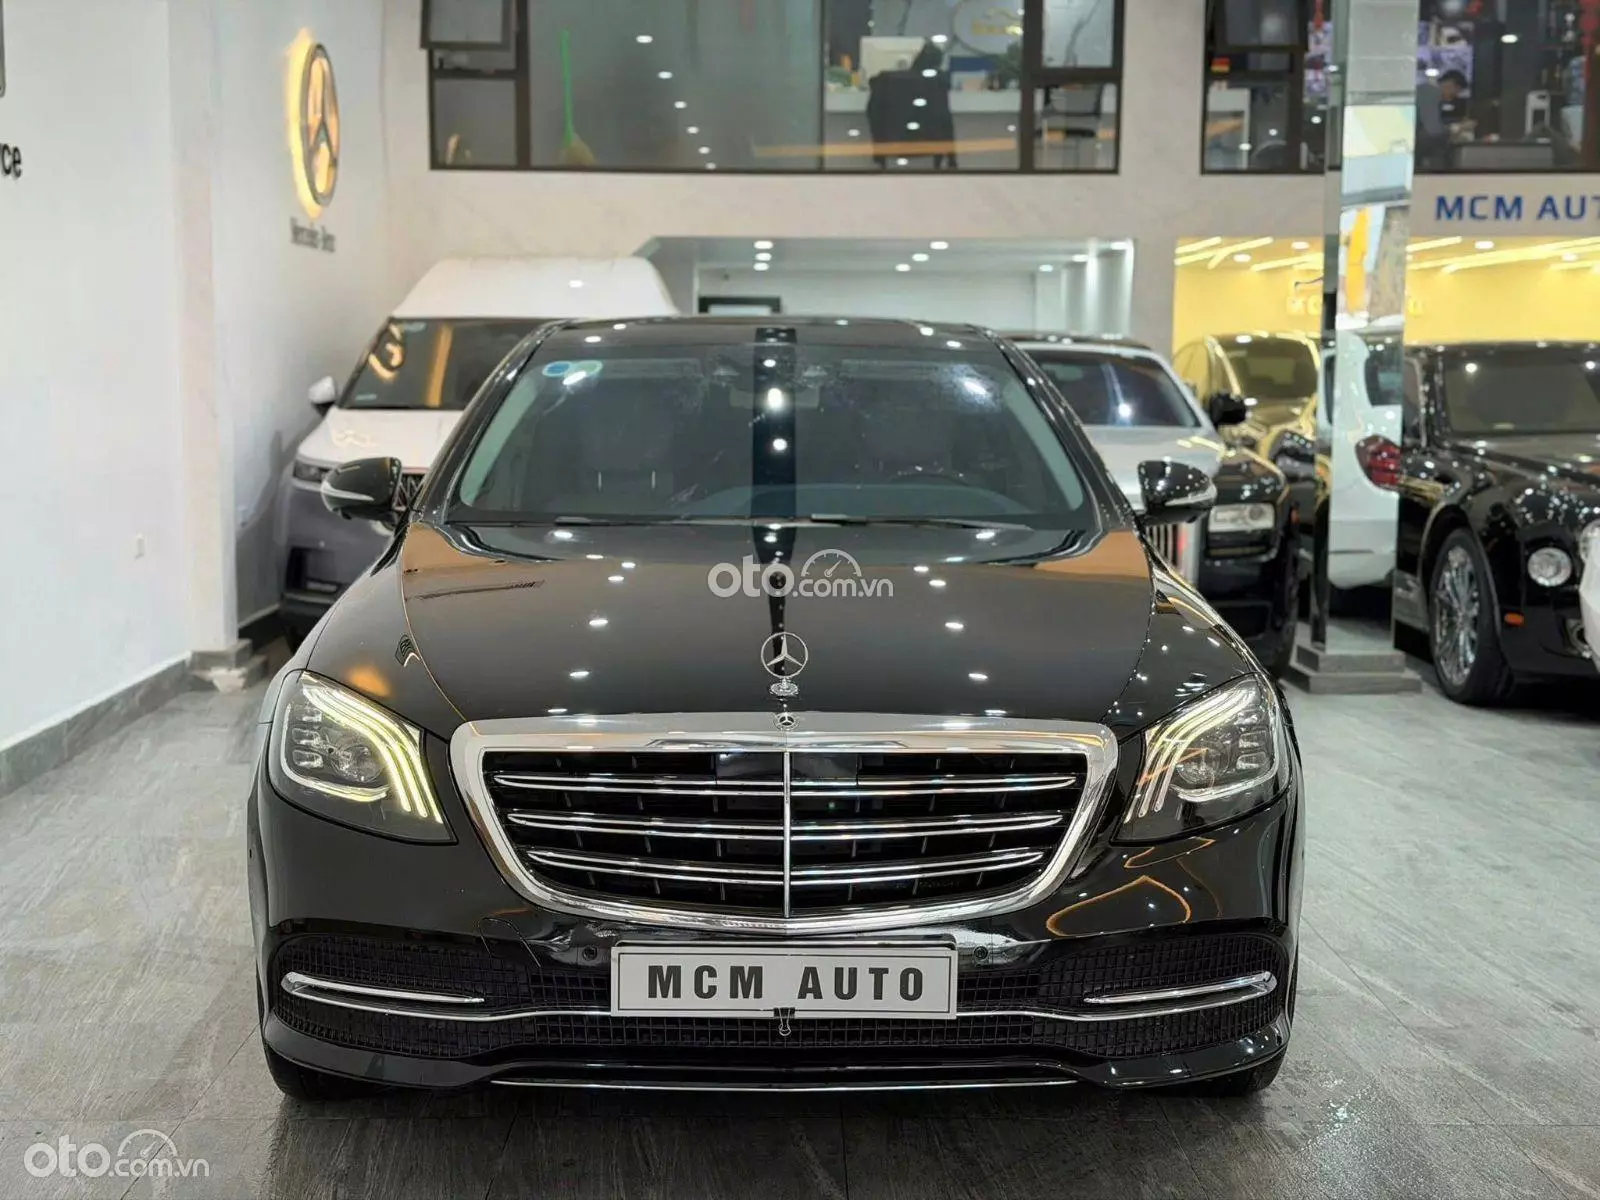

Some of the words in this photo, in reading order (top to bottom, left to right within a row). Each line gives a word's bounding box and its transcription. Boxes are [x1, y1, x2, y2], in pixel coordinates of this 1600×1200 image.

[0, 143, 22, 179] ce
[1435, 195, 1523, 221] MCM
[648, 965, 763, 999] MCM
[797, 966, 923, 1001] AUTO
